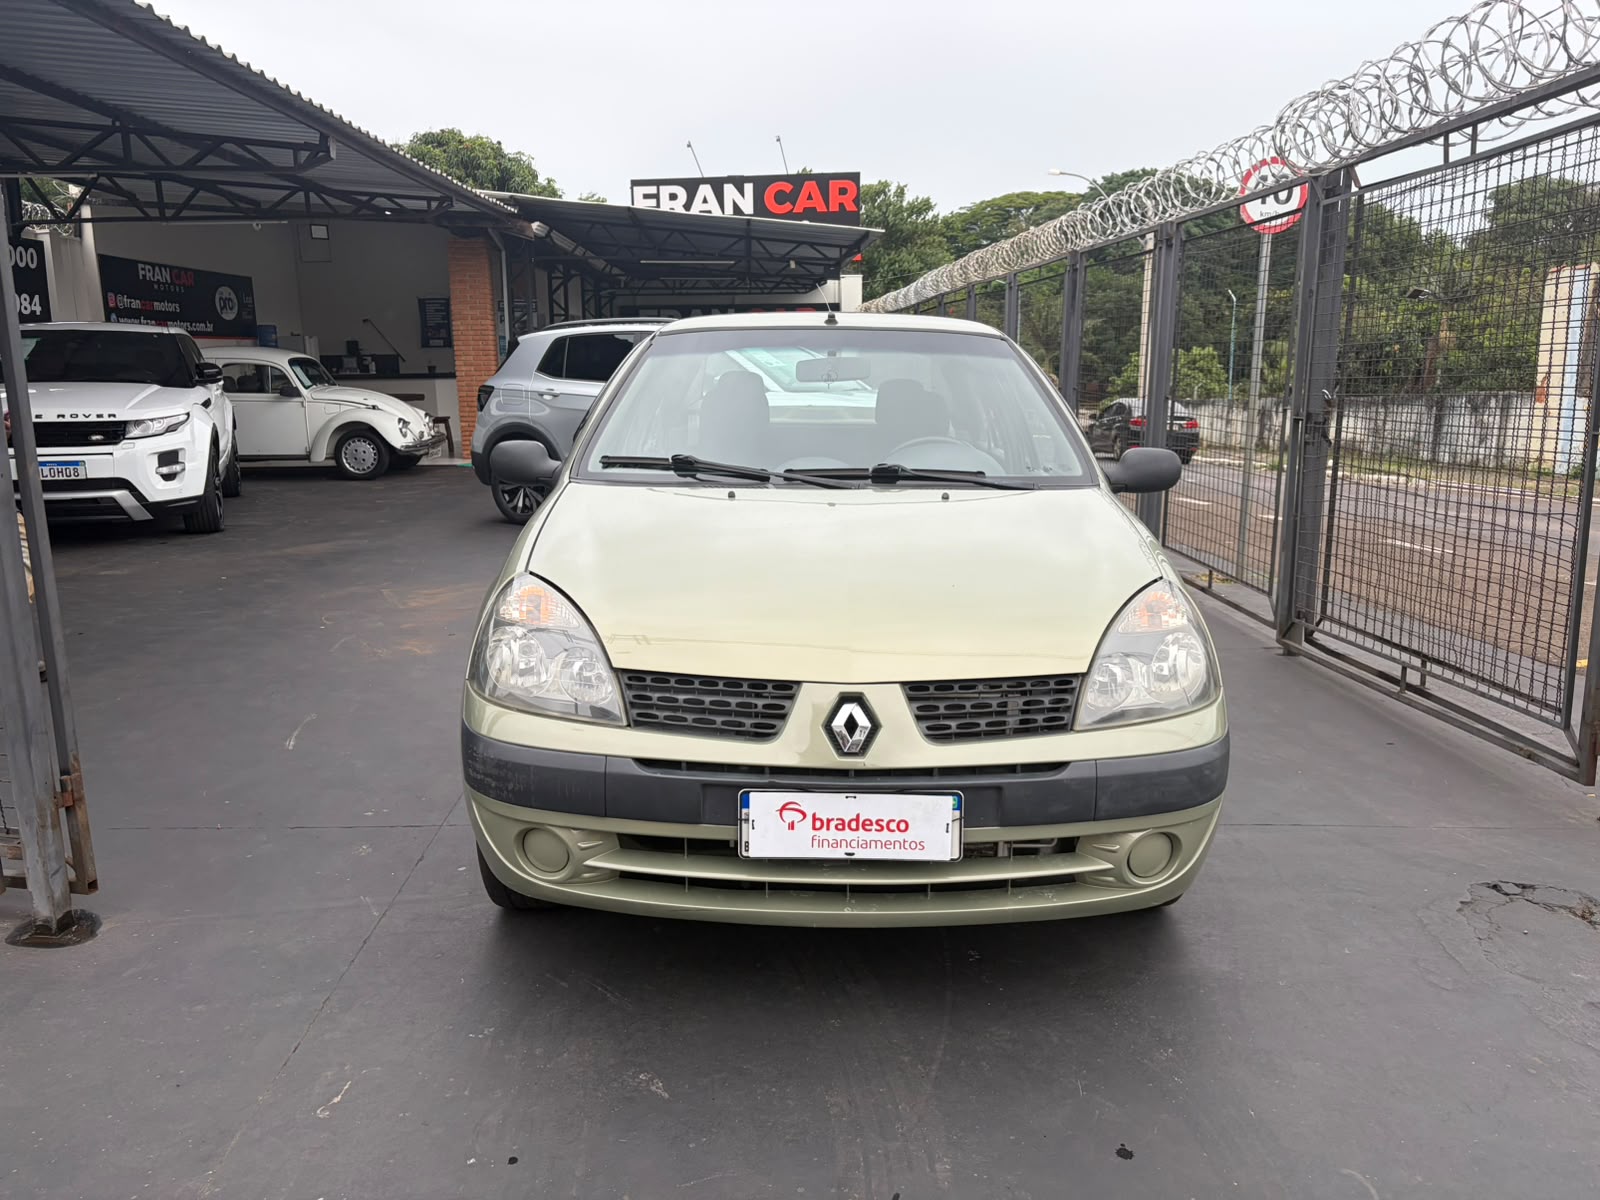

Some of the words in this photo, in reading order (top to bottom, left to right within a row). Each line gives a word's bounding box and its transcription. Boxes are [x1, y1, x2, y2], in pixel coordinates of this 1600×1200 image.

[633, 183, 754, 216] FRAN
[764, 180, 858, 215] CAR
[138, 263, 171, 283] FRAN
[172, 269, 195, 287] CAR
[153, 284, 185, 293] MOTORS
[117, 294, 180, 313] @francarmotors
[118, 316, 214, 332] wwwfrancarmotors.com.br
[812, 812, 909, 833] bradesco
[811, 834, 926, 851] financiamentos
